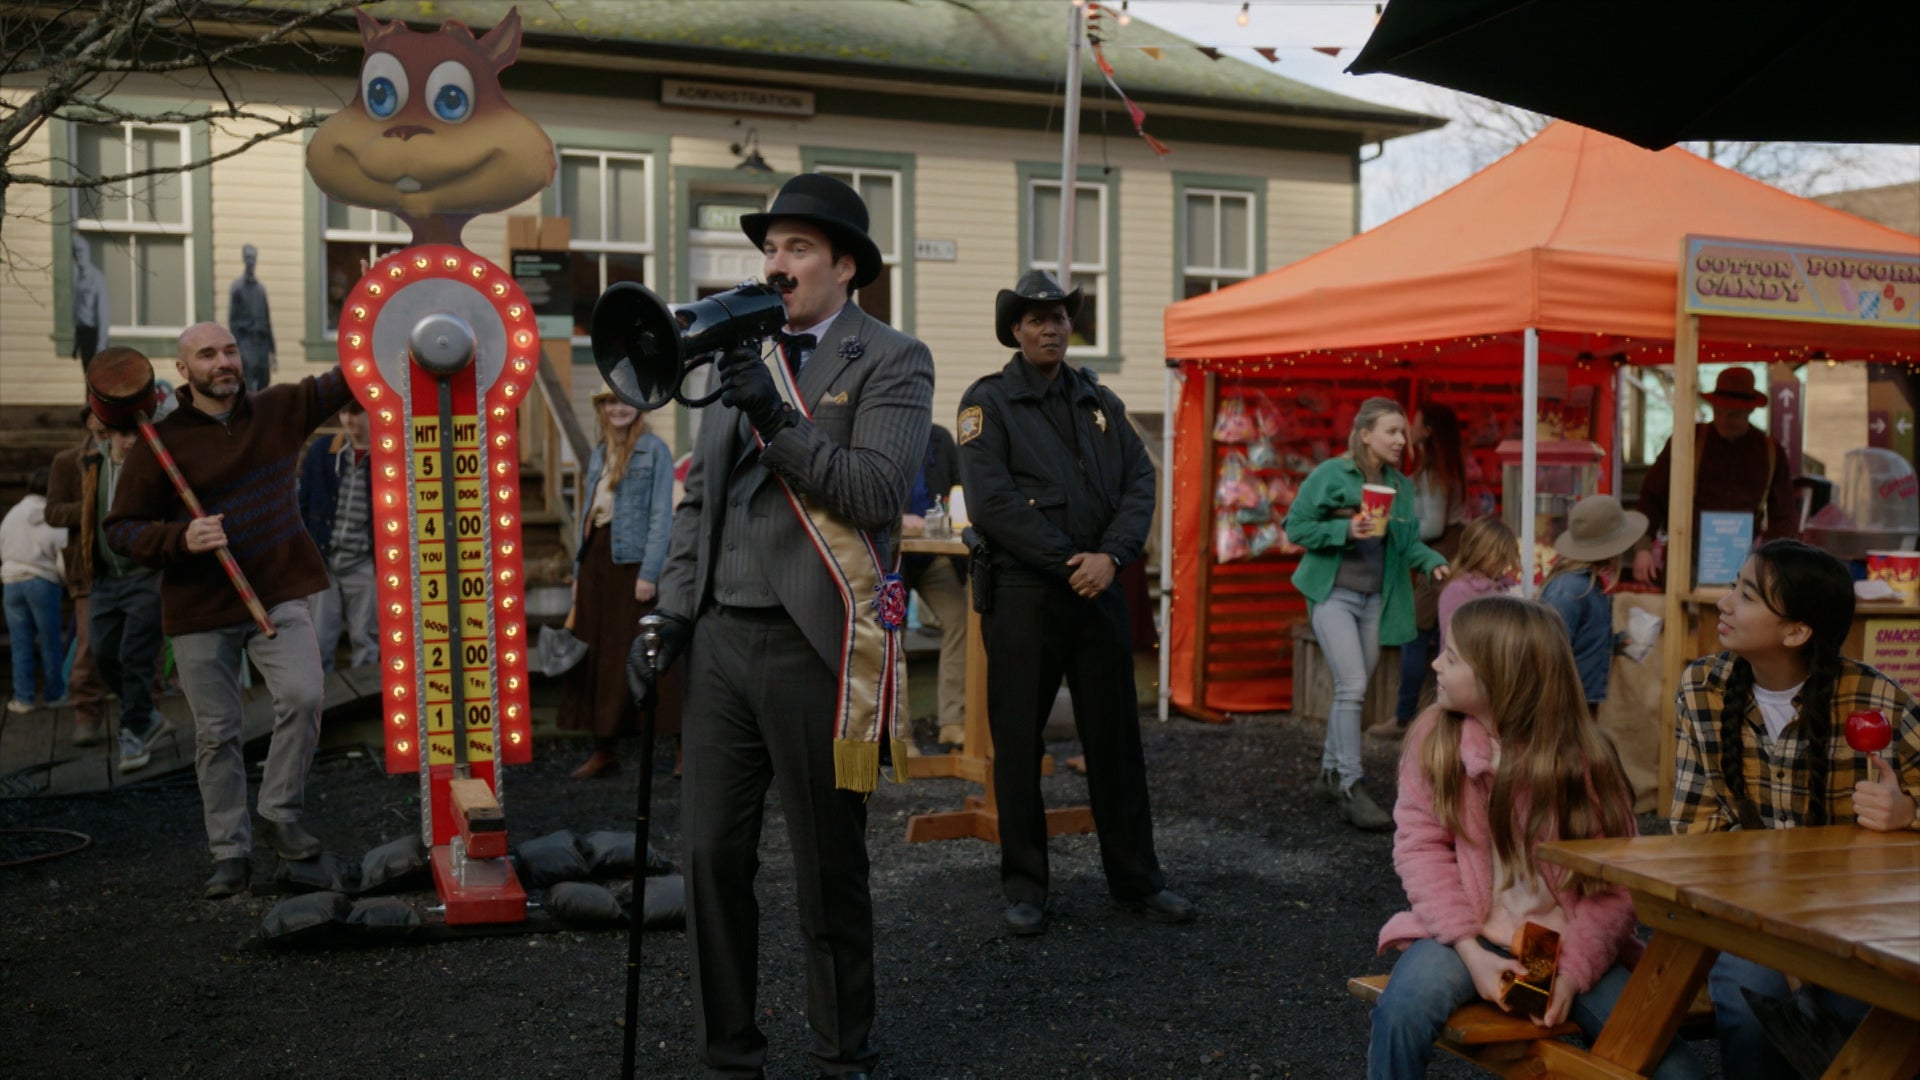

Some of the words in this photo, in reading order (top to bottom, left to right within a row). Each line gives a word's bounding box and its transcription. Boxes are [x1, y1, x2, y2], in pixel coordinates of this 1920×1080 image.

[676, 86, 804, 108] ADMINISTRATION
[1696, 257, 1792, 279] COTTON
[1696, 276, 1802, 302] CANDY
[415, 425, 437, 443] HIT
[454, 423, 476, 442] HIT
[423, 455, 433, 476] 5
[456, 454, 478, 475] 00
[420, 490, 439, 501] TOP
[458, 488, 479, 500] DOG
[424, 517, 435, 536] 4
[459, 515, 481, 536] 00
[422, 552, 442, 563] YOU
[461, 550, 482, 561] CAN
[428, 579, 438, 600] 3
[462, 577, 484, 598] 00
[424, 619, 448, 634] GOOD
[466, 616, 484, 630] ONE
[432, 647, 442, 667] 2
[466, 644, 488, 665] 00
[429, 680, 450, 694] NICE
[470, 677, 486, 690] TRY
[435, 708, 443, 728] 1
[469, 705, 491, 725] 00
